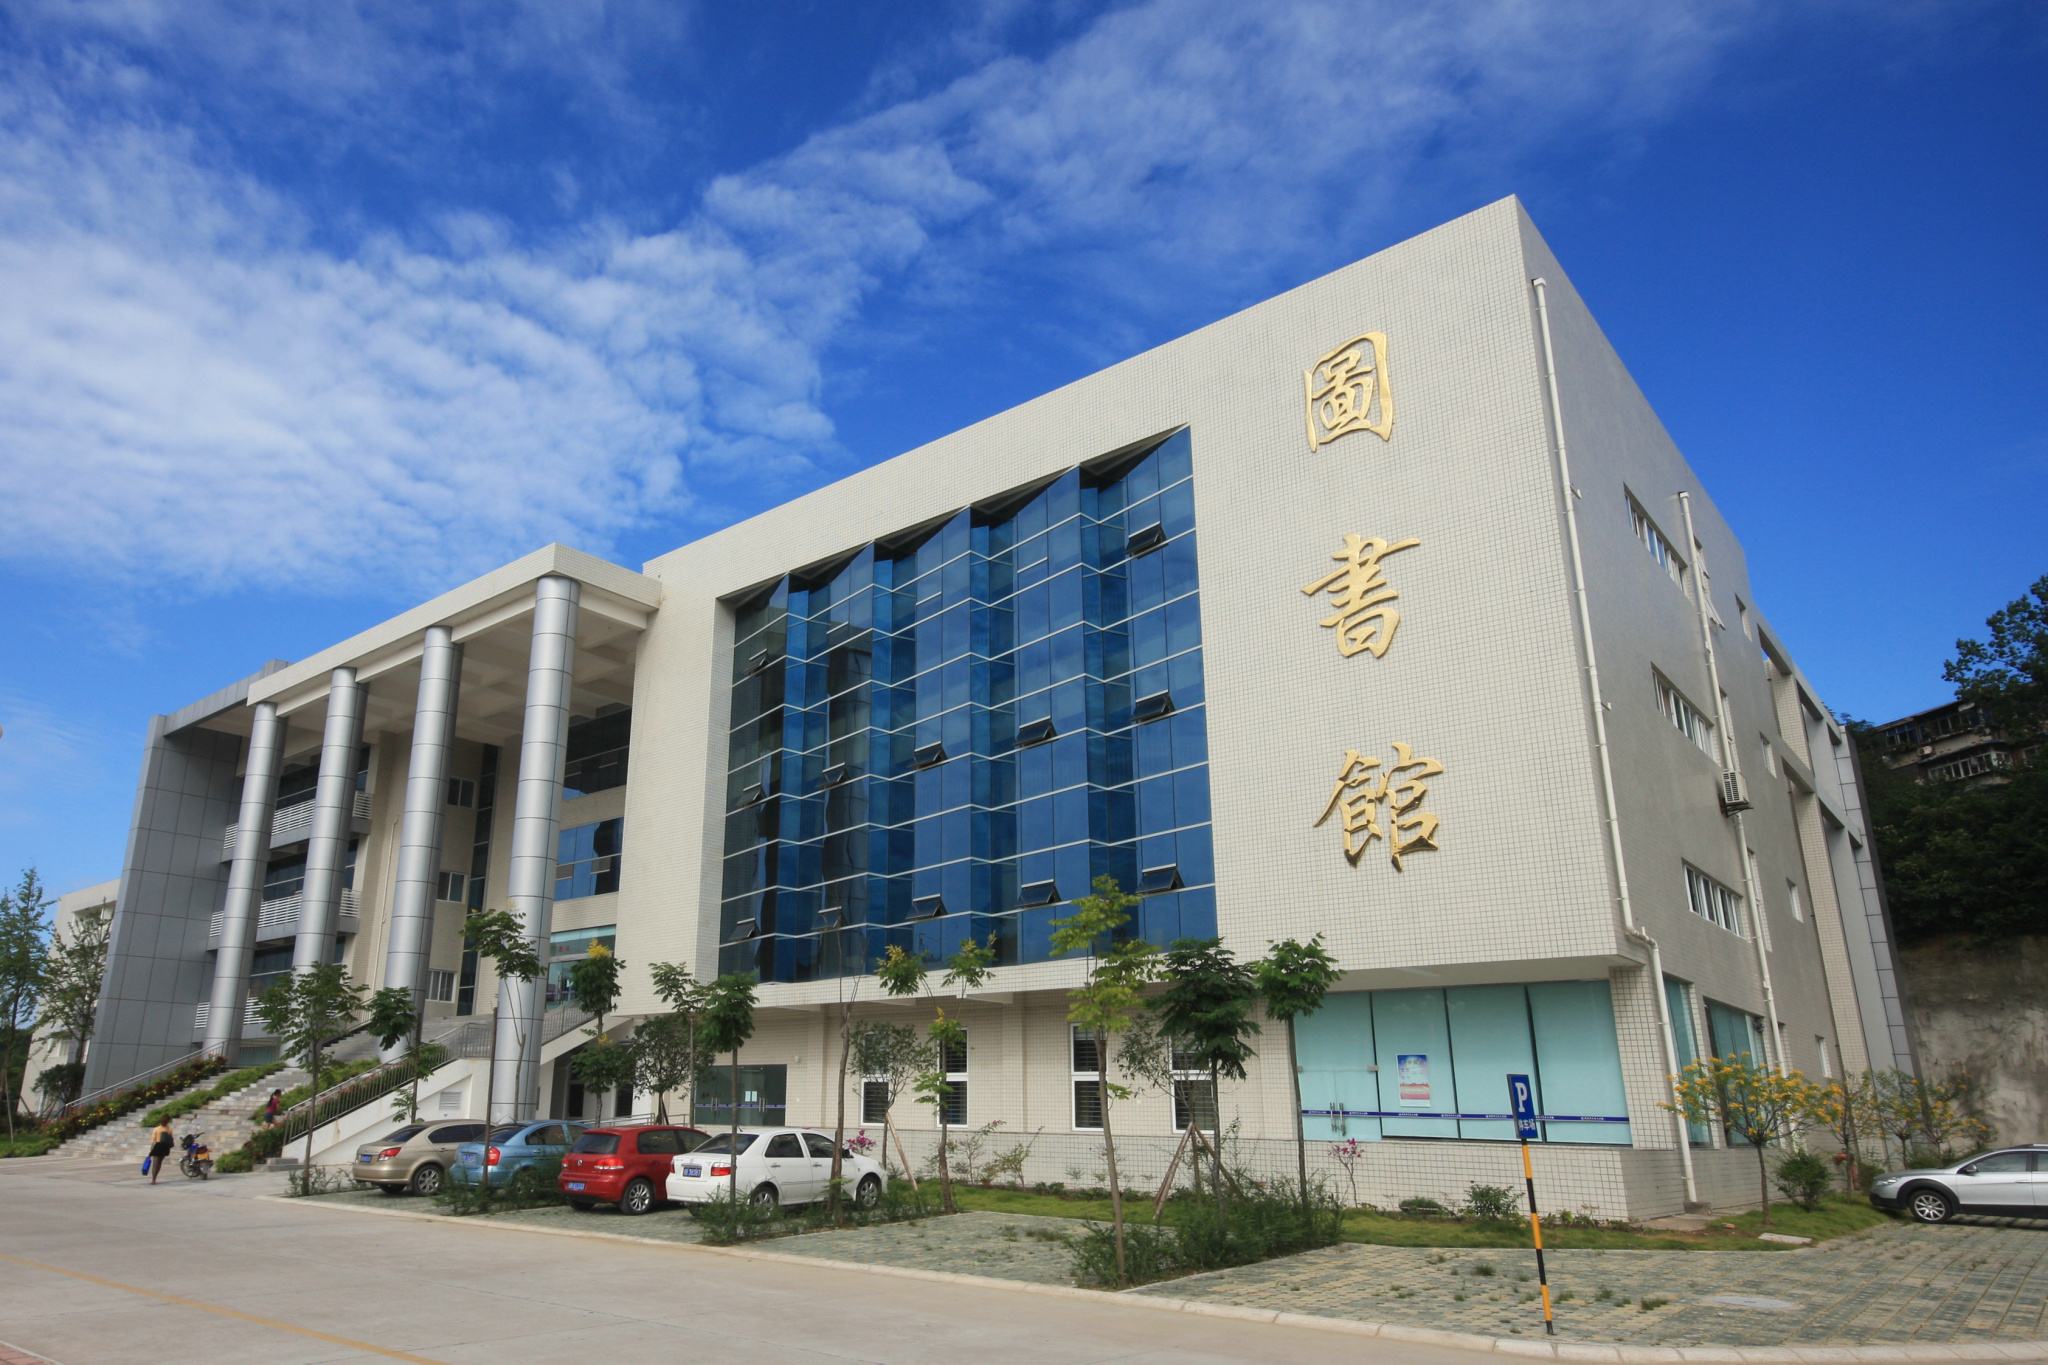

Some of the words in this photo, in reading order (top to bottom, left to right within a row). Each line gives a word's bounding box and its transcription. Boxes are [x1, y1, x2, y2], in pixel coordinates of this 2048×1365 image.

[1301, 331, 1443, 872] 圖書館
[1515, 1082, 1528, 1113] P
